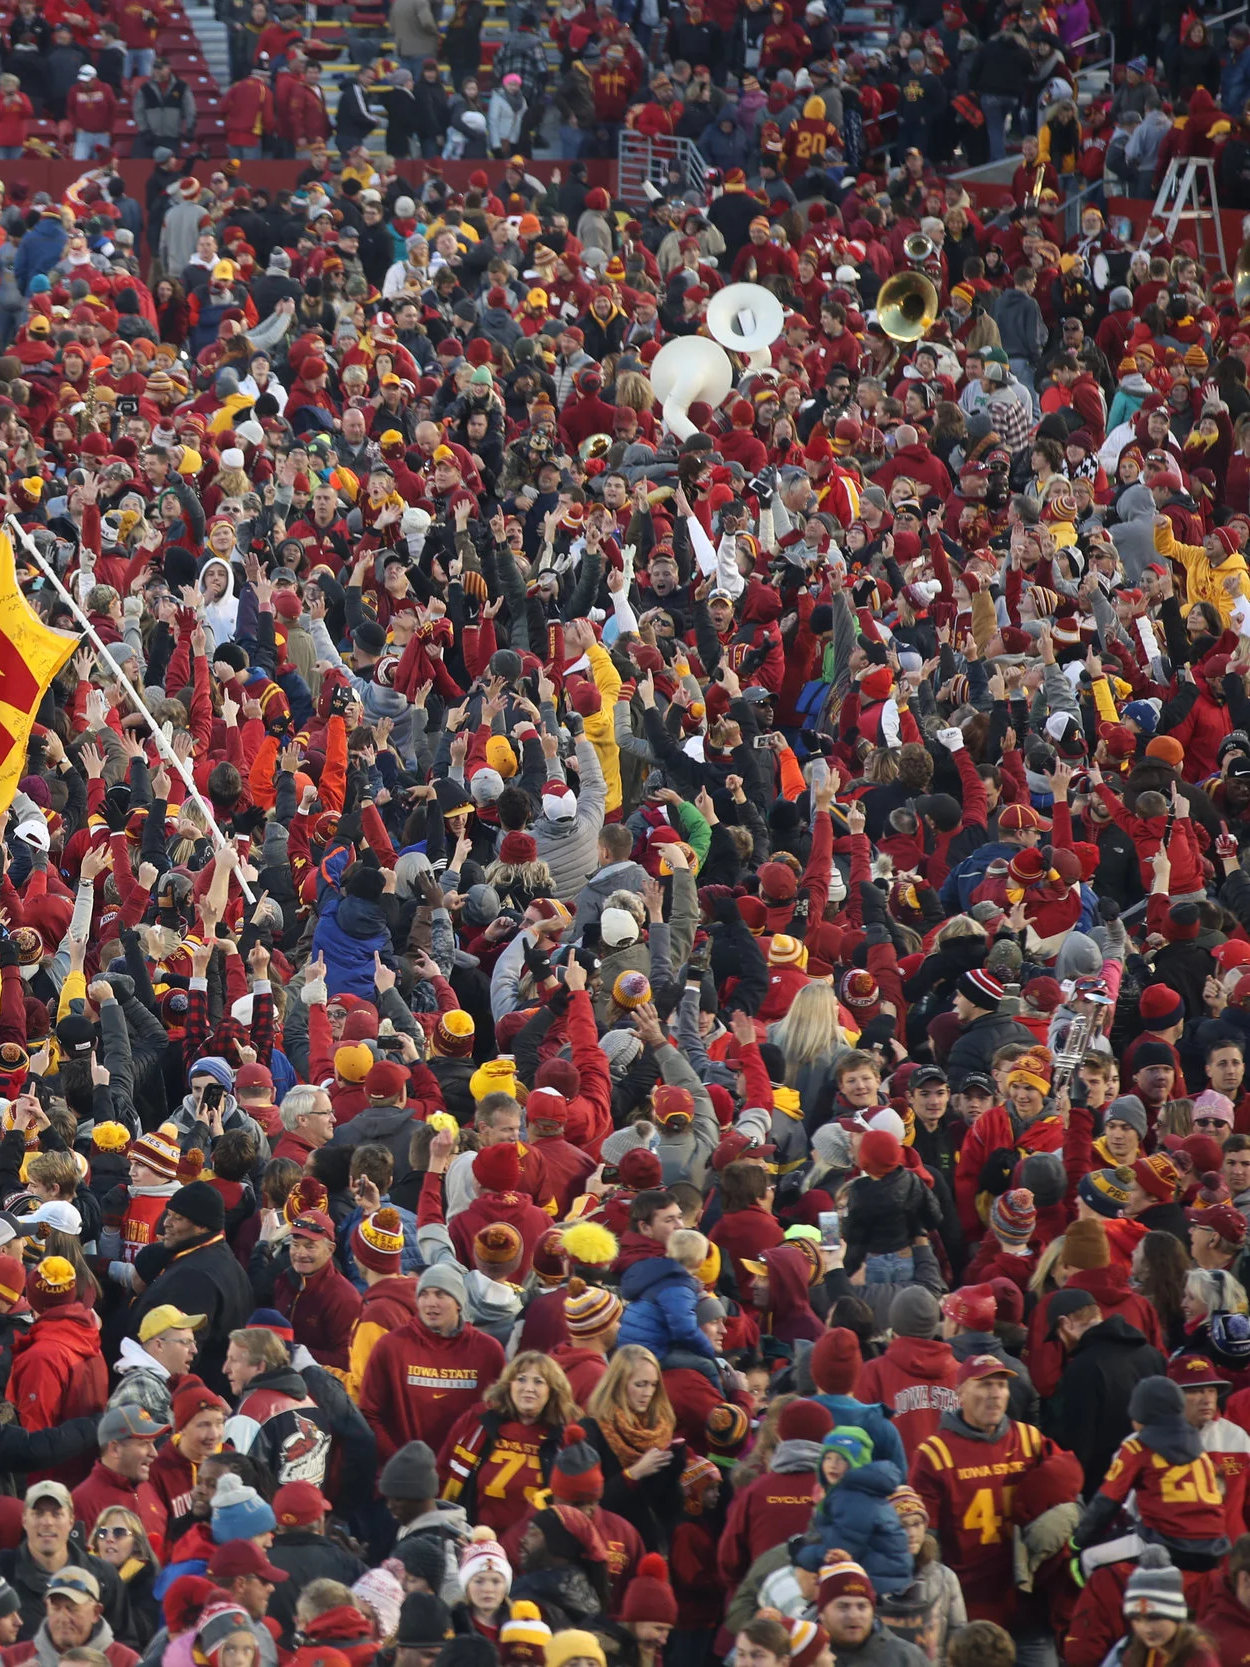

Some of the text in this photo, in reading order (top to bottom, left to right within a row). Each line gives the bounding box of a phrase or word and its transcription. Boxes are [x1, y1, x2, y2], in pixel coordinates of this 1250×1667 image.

[407, 1364, 478, 1380] IOWA STATE
[893, 1386, 929, 1417] IOWA
[957, 1461, 1025, 1481] IOWA STATE
[1161, 1451, 1224, 1506] 20
